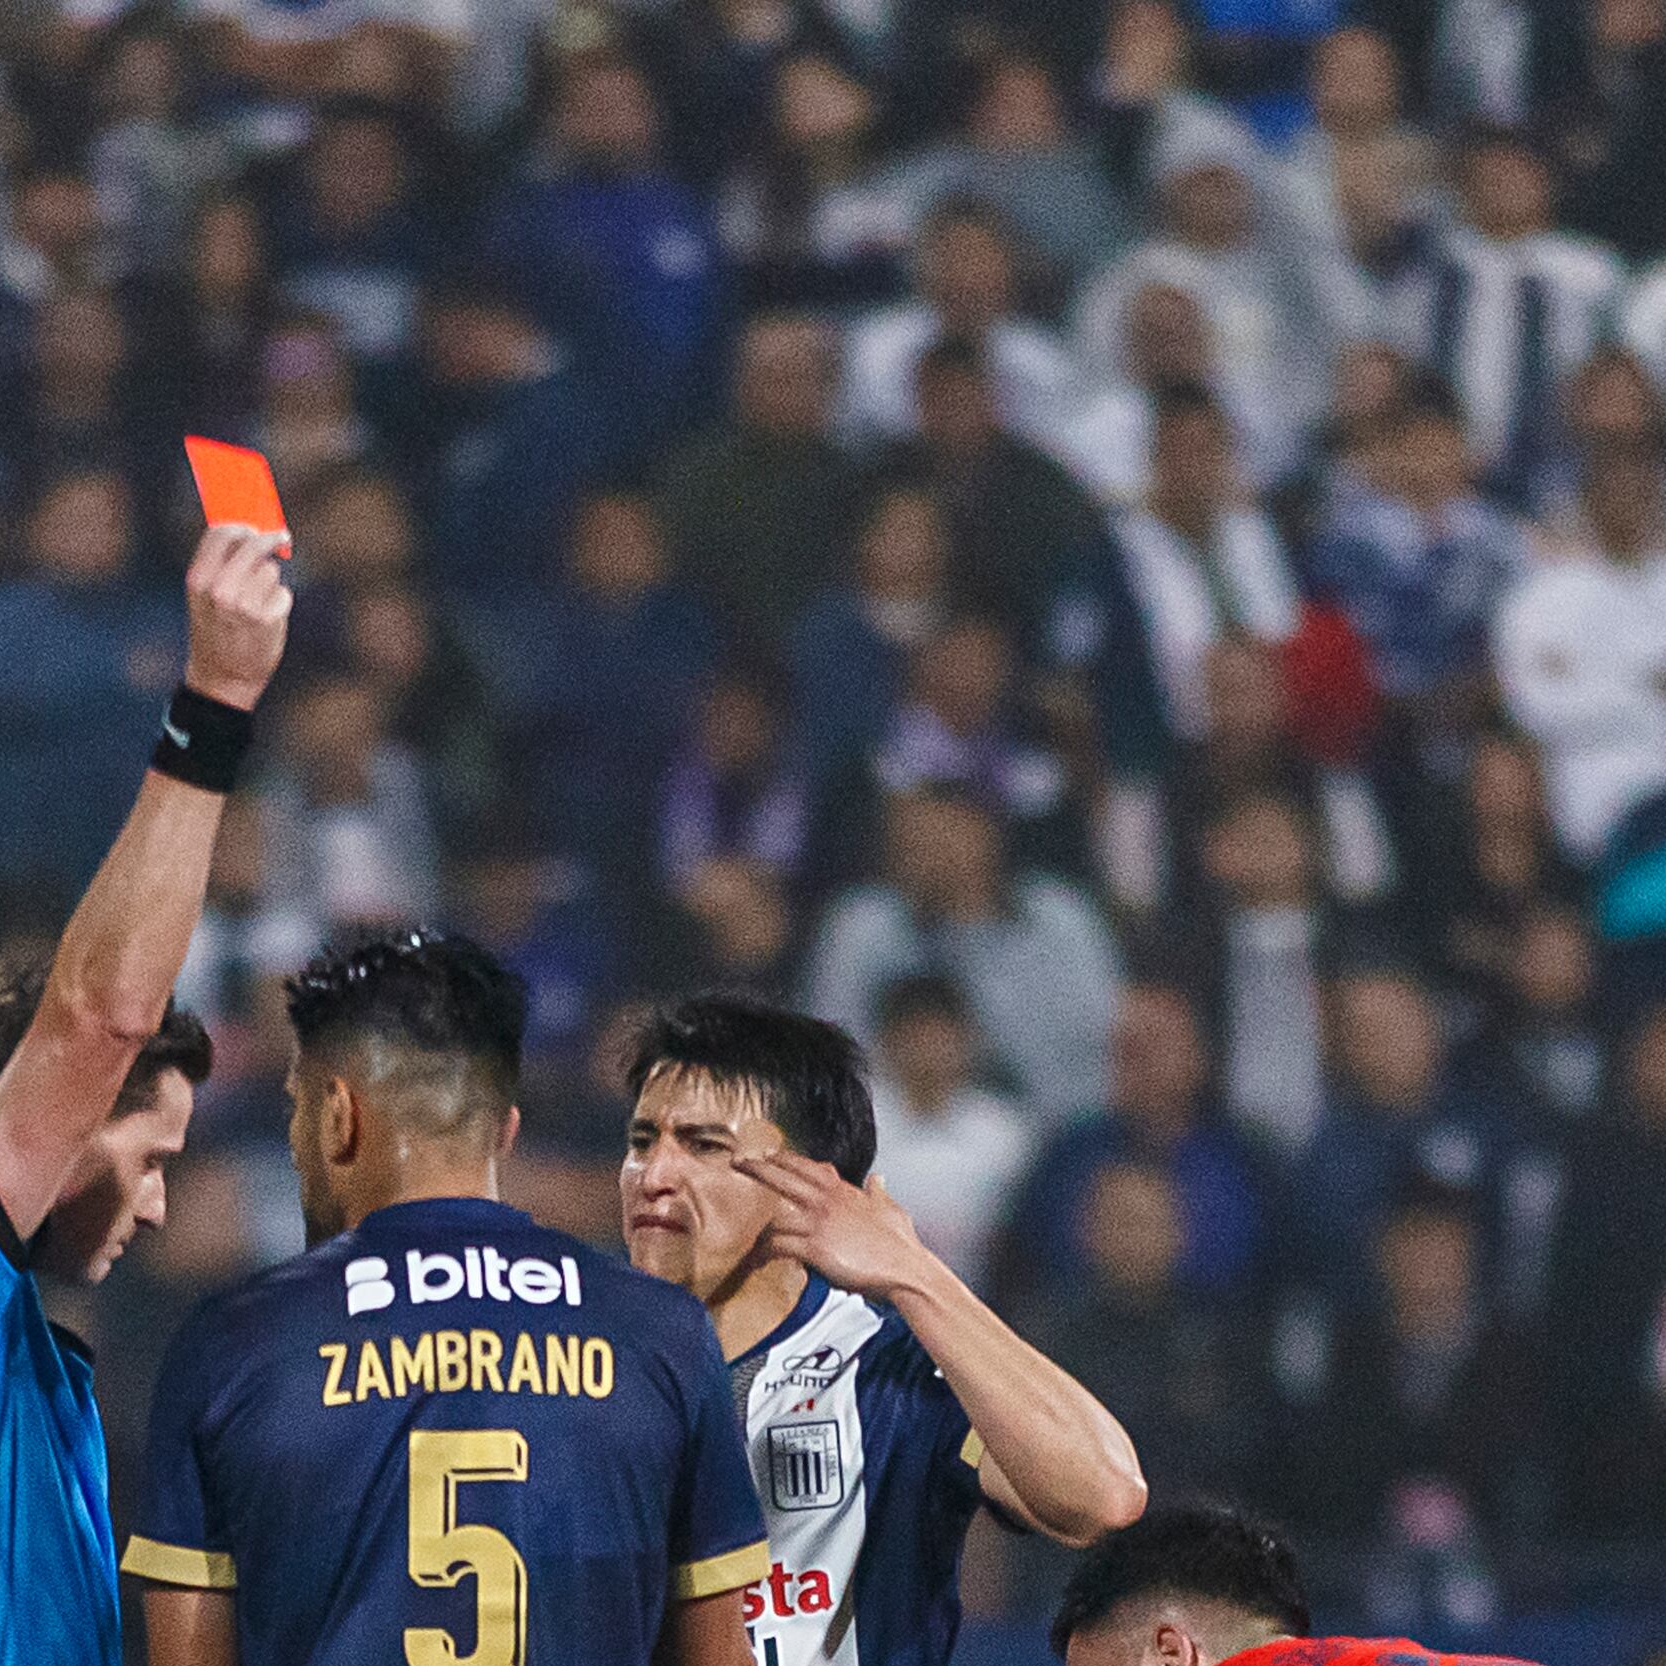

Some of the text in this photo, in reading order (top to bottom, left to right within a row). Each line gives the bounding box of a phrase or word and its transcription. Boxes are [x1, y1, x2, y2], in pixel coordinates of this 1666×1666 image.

[406, 1246, 582, 1305] bitel
[319, 1329, 614, 1406] ZAMBRANO
[764, 1374, 833, 1394] HYUND
